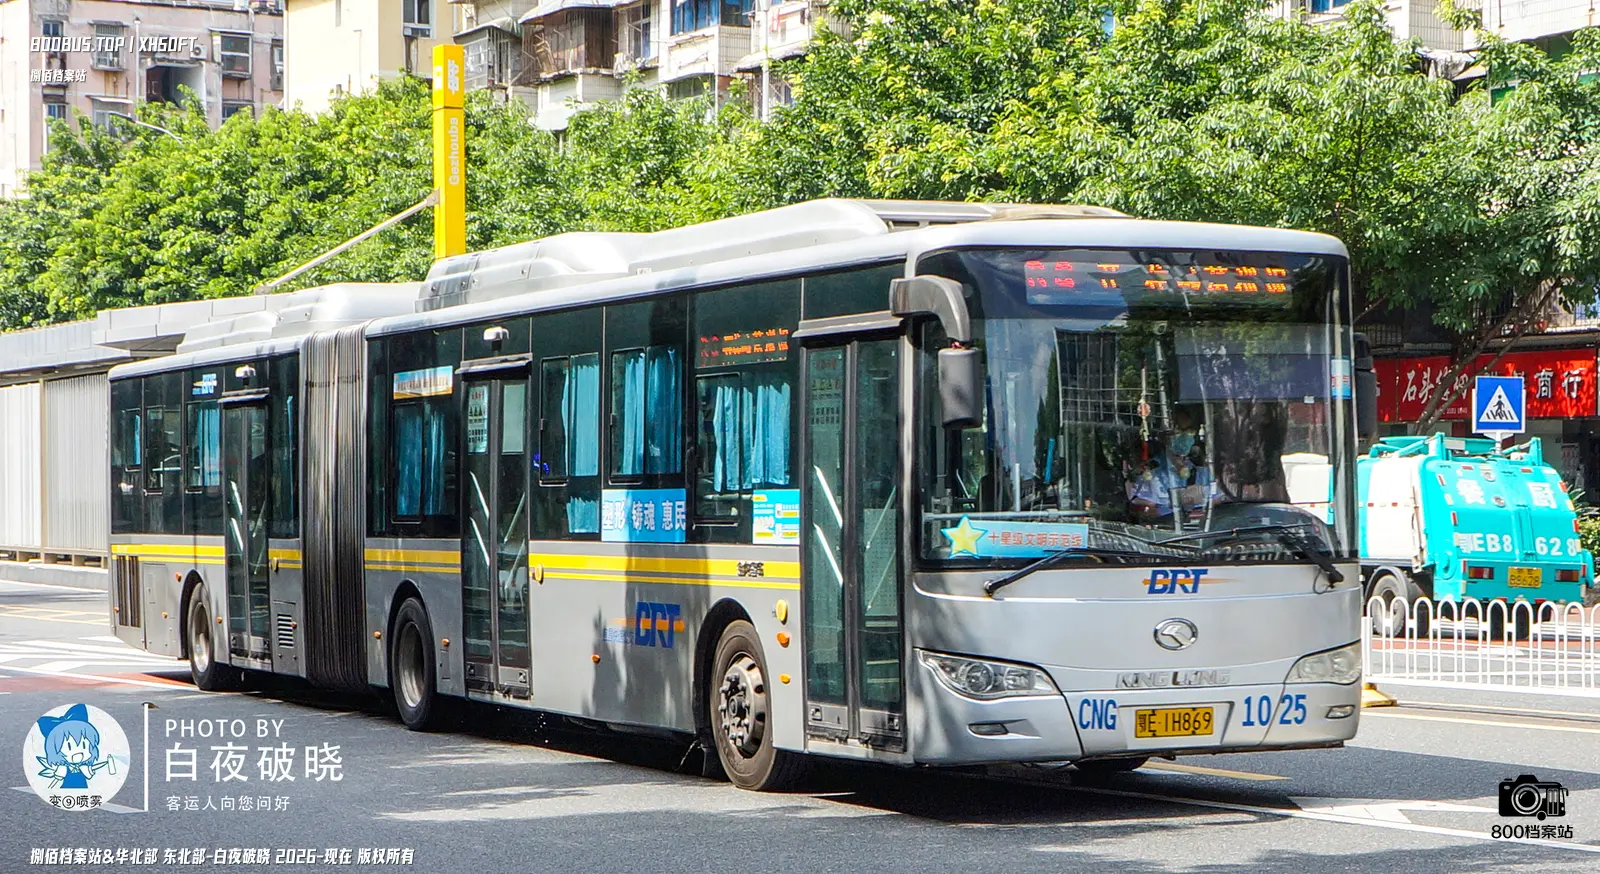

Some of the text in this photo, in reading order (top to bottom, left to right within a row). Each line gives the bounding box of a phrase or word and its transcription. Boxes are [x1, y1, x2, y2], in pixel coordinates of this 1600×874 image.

[448, 117, 460, 186] Gezhouba
[662, 500, 686, 531] 惠民
[1147, 569, 1208, 594] BRT
[1115, 669, 1232, 689] KING LONG
[1078, 698, 1118, 730] CNG
